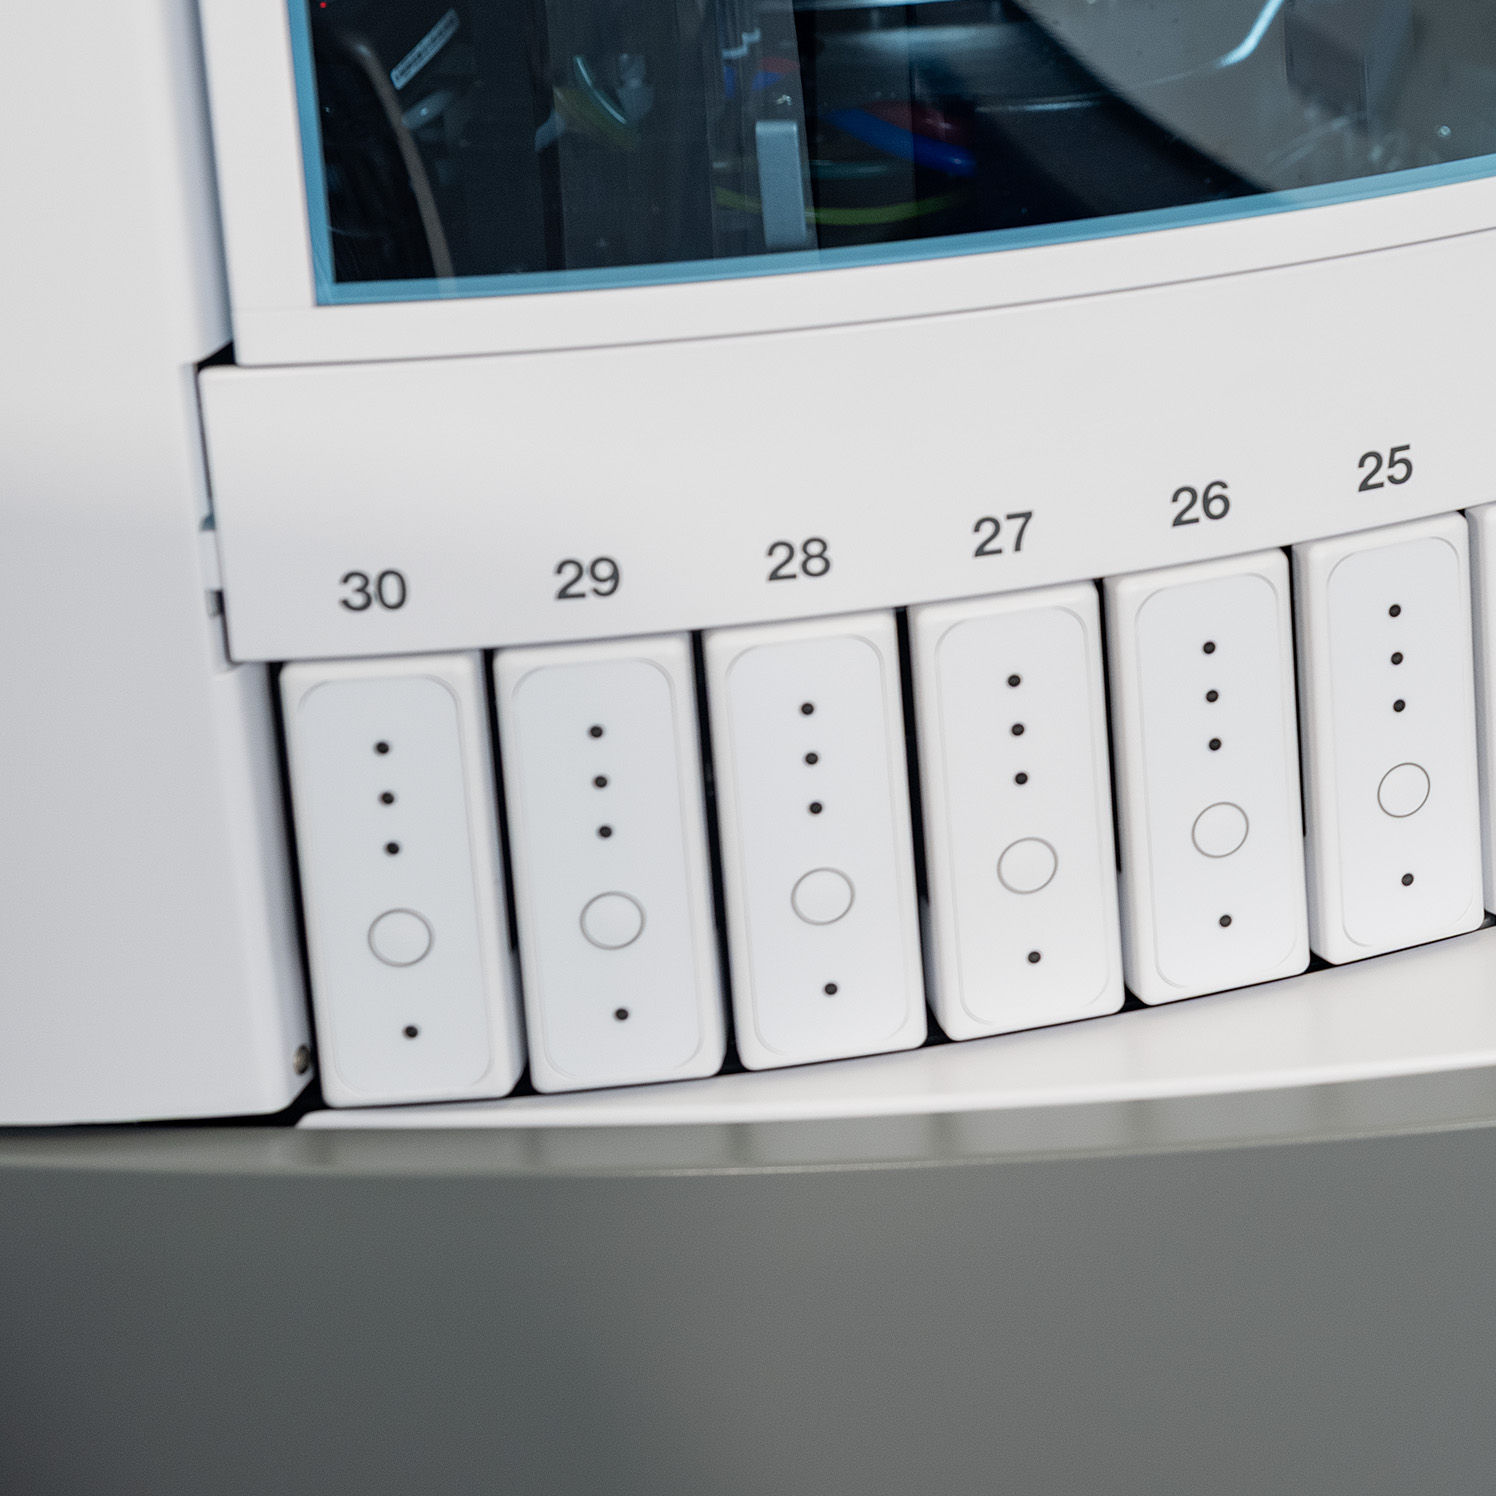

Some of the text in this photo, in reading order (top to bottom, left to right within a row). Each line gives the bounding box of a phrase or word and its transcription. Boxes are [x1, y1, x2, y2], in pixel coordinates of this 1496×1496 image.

[341, 569, 407, 612] 30
[556, 557, 620, 600] 29
[767, 537, 831, 582] 28
[973, 511, 1033, 558] 27
[1171, 480, 1230, 527] 26
[1358, 444, 1413, 493] 25
